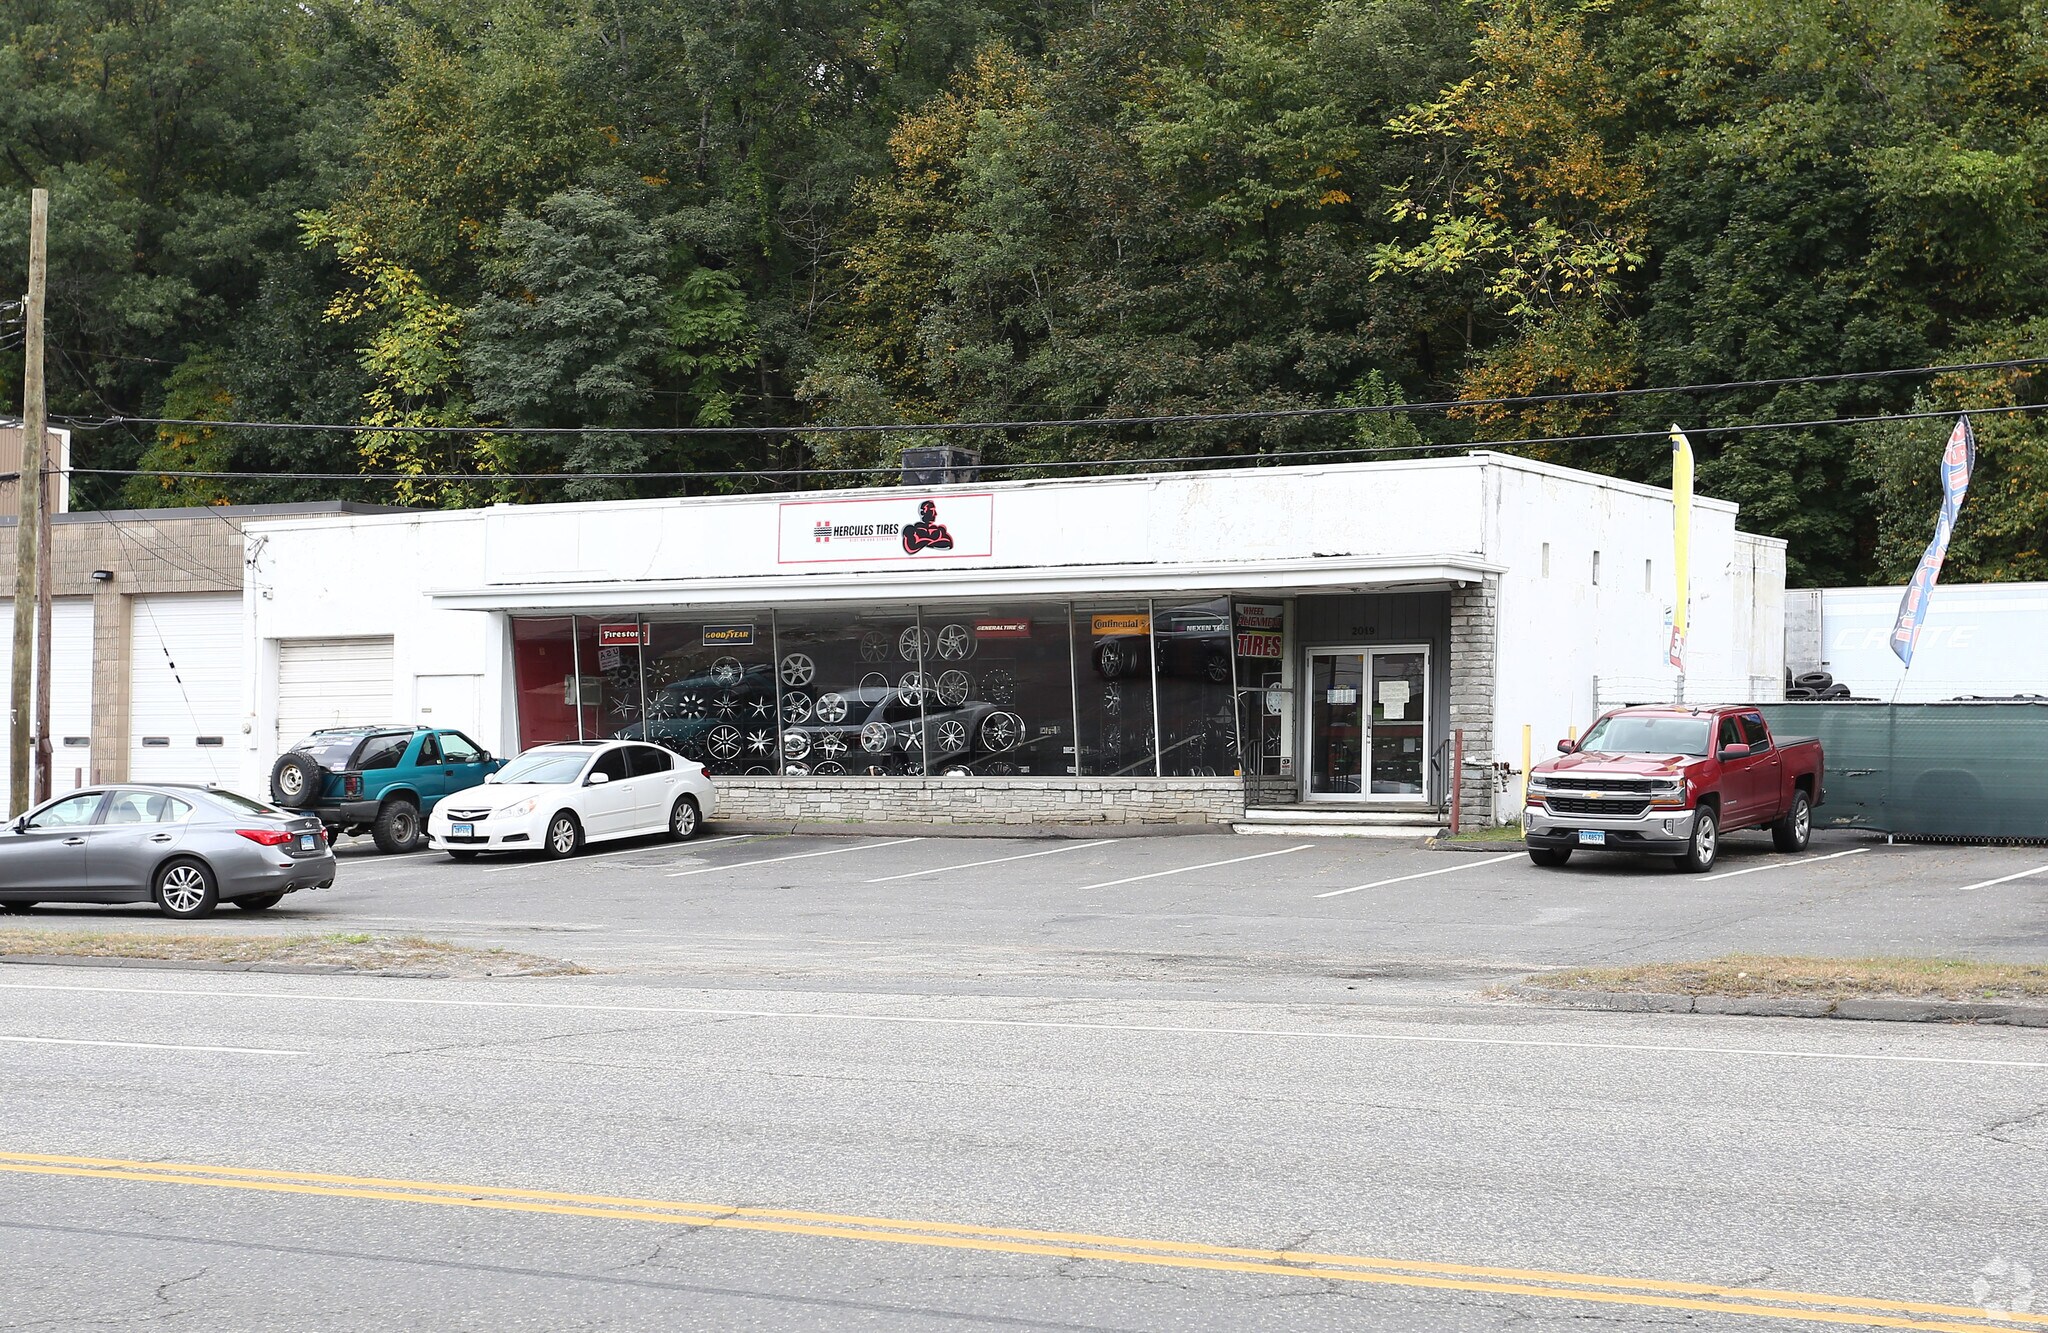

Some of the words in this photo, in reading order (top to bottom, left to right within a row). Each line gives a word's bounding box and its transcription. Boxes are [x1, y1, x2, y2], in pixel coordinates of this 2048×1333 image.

[833, 525, 874, 537] HERCULES
[876, 523, 899, 535] TIRES
[1243, 606, 1265, 616] WHEEL
[1094, 619, 1138, 629] Continental
[705, 630, 749, 640] GOODYEAR
[1352, 626, 1375, 635] 2019
[1832, 624, 1980, 650] CRTE
[1237, 633, 1282, 657] TIRES
